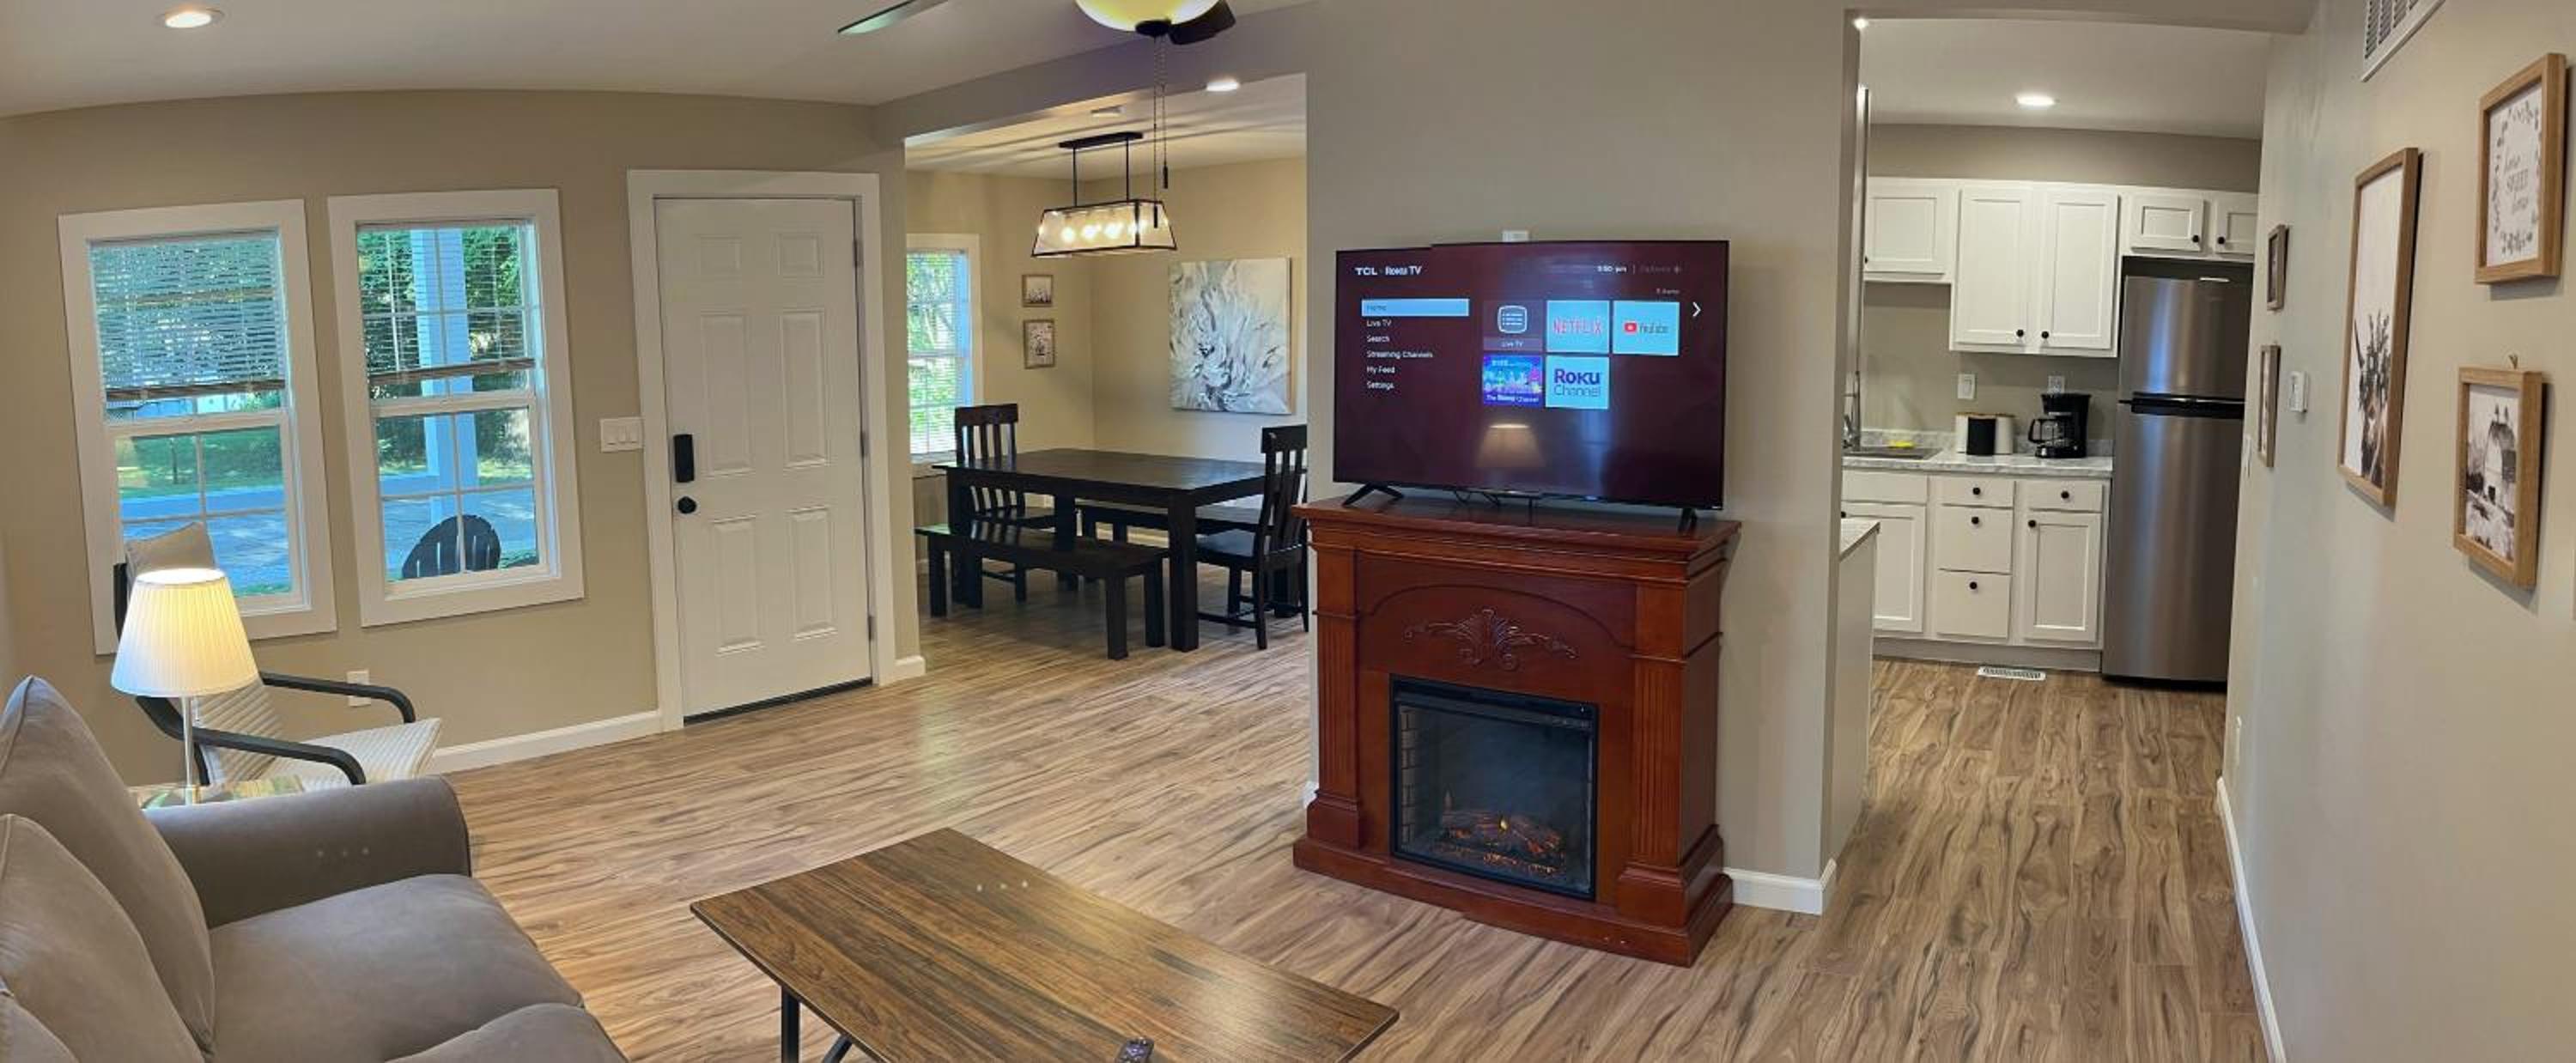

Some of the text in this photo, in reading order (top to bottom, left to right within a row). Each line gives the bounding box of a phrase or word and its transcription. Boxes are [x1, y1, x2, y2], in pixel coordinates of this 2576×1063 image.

[1356, 265, 1422, 276] TCL Roku TV
[1553, 319, 1601, 334] NETFLIX
[1639, 322, 1668, 334] YouTube
[1366, 350, 1401, 360] Streaming
[1366, 366, 1377, 374] My
[1554, 368, 1601, 385] Roku
[1366, 381, 1394, 391] Settings
[1553, 384, 1601, 398] Channel
